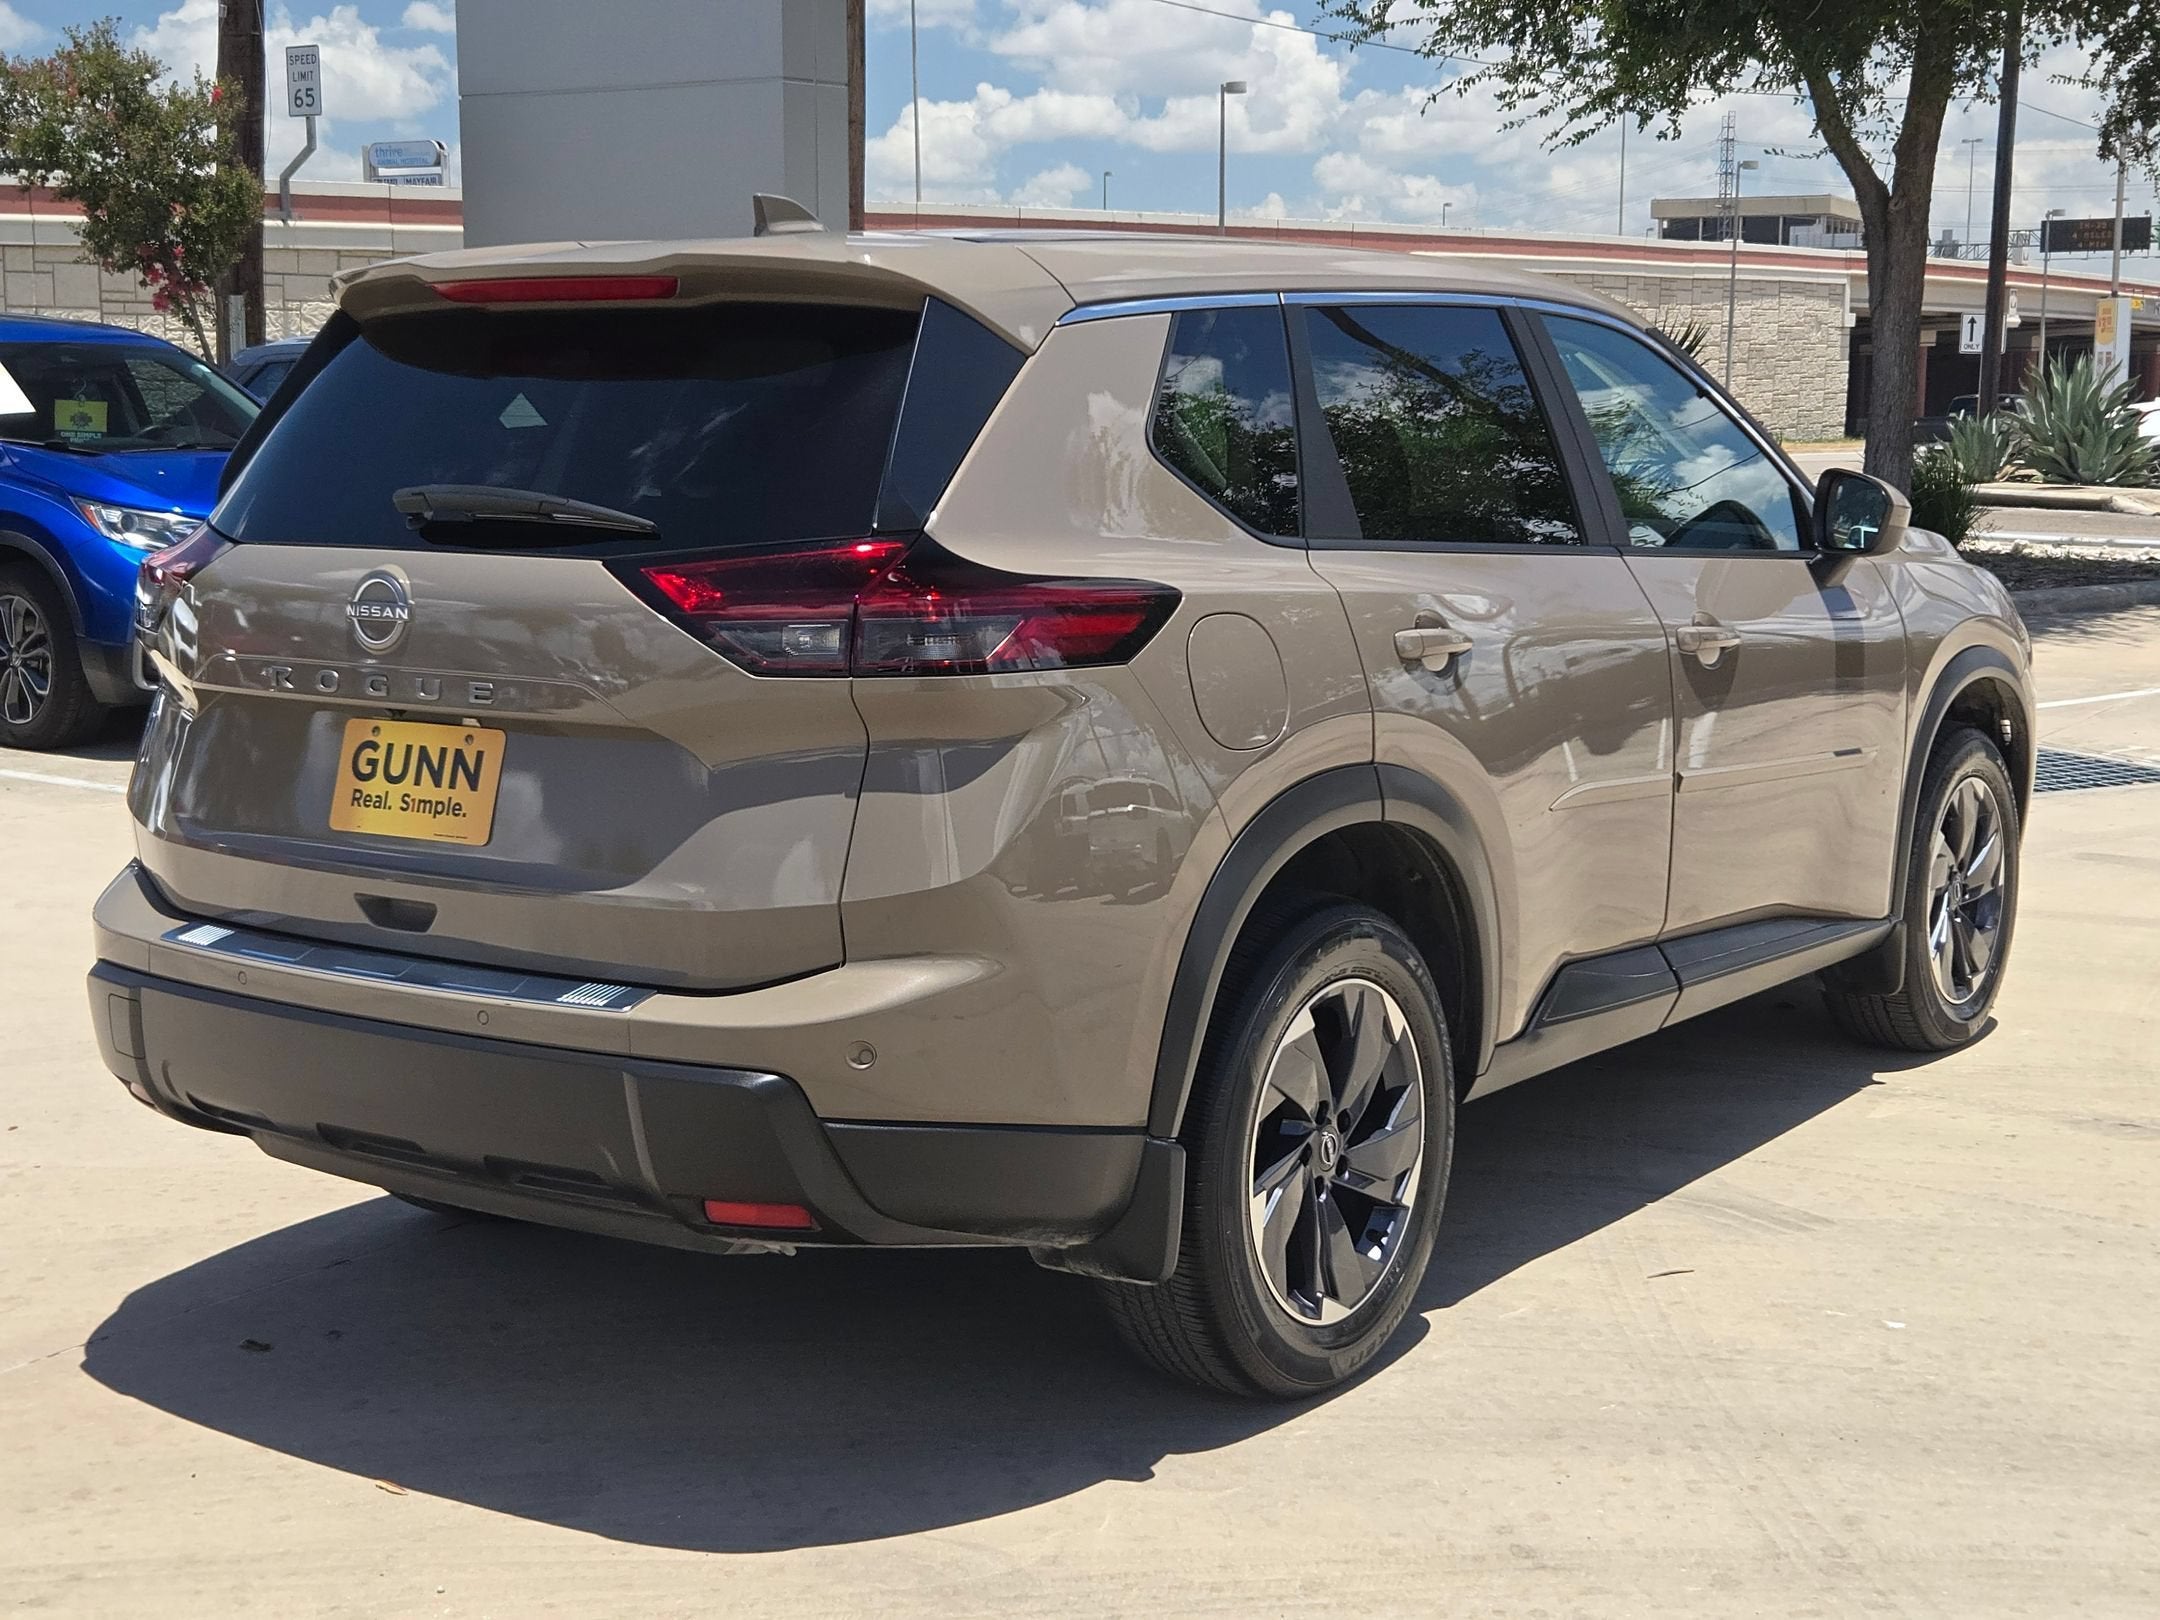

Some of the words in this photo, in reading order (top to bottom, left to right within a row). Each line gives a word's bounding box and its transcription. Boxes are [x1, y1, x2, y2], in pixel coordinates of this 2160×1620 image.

[289, 54, 317, 65] SPEED
[292, 71, 314, 82] LIMIT
[294, 87, 315, 108] 65
[375, 145, 403, 158] thrive
[346, 604, 409, 620] NISSAN
[268, 665, 495, 705] ROGUE
[351, 739, 485, 792] GUNN
[350, 788, 392, 810] Real.
